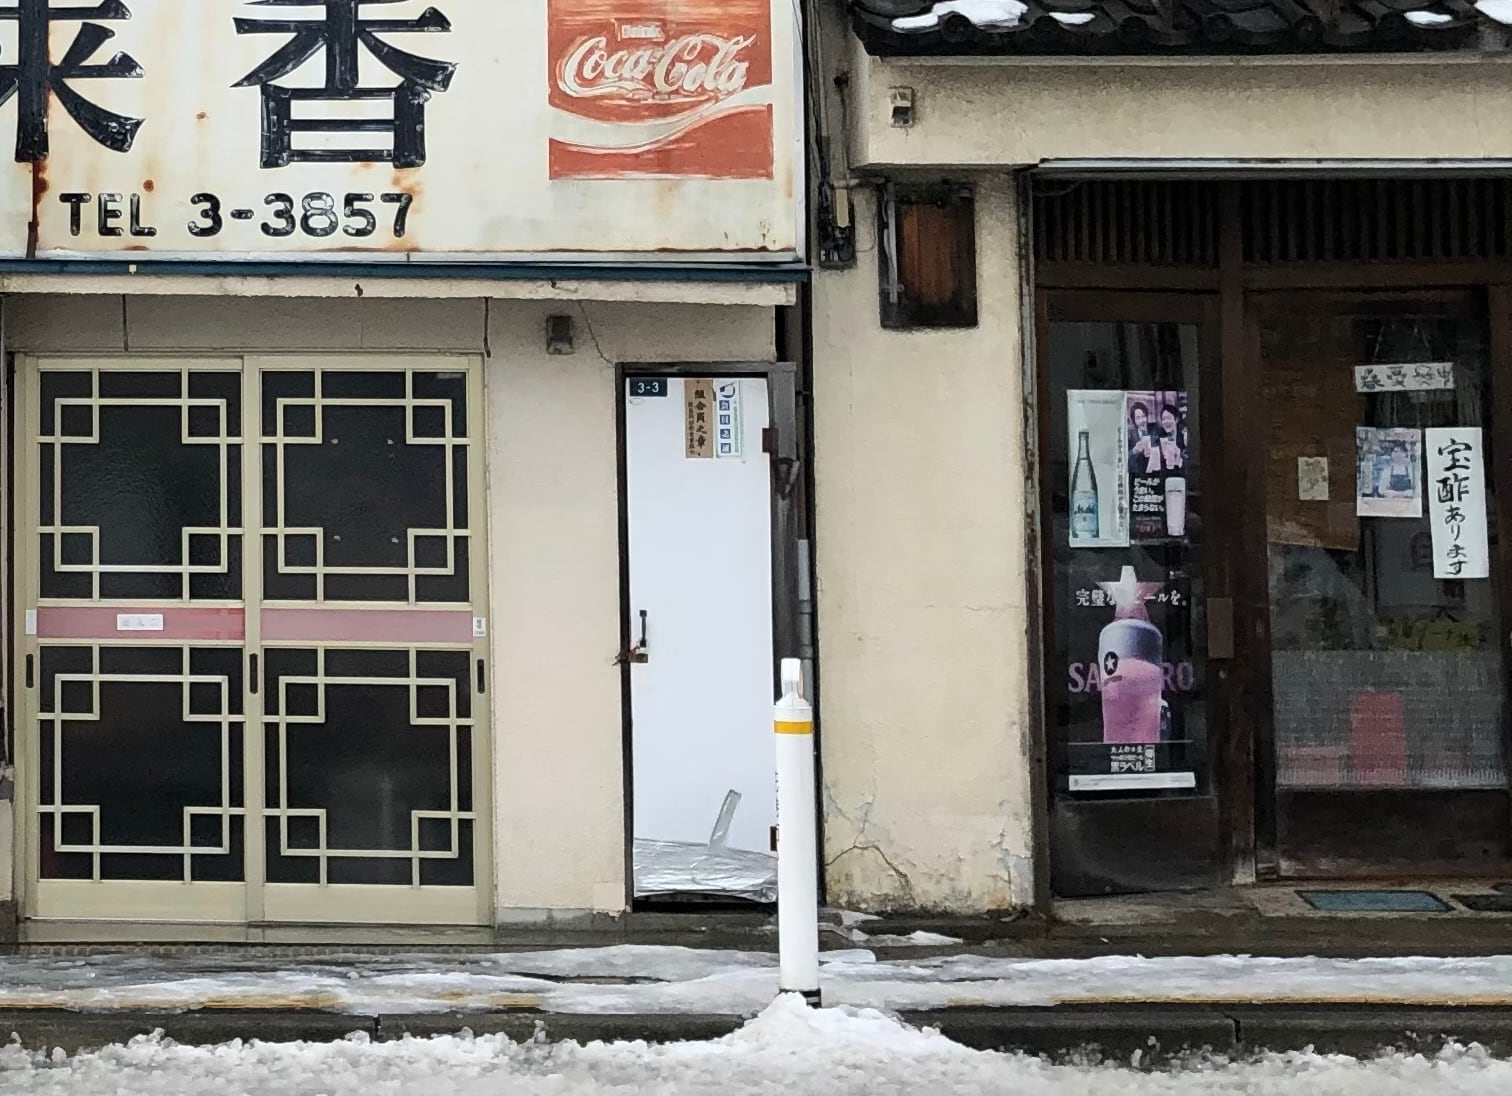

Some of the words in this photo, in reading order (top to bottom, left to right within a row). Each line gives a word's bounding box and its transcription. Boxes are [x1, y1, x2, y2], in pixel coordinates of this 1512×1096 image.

[556, 33, 756, 102] Coca-Cola
[60, 193, 156, 238] TEL
[189, 192, 413, 238] 3-3857
[637, 382, 659, 394] 3-3
[1435, 438, 1473, 575] 宝酢あります
[1068, 661, 1194, 693] SARO
